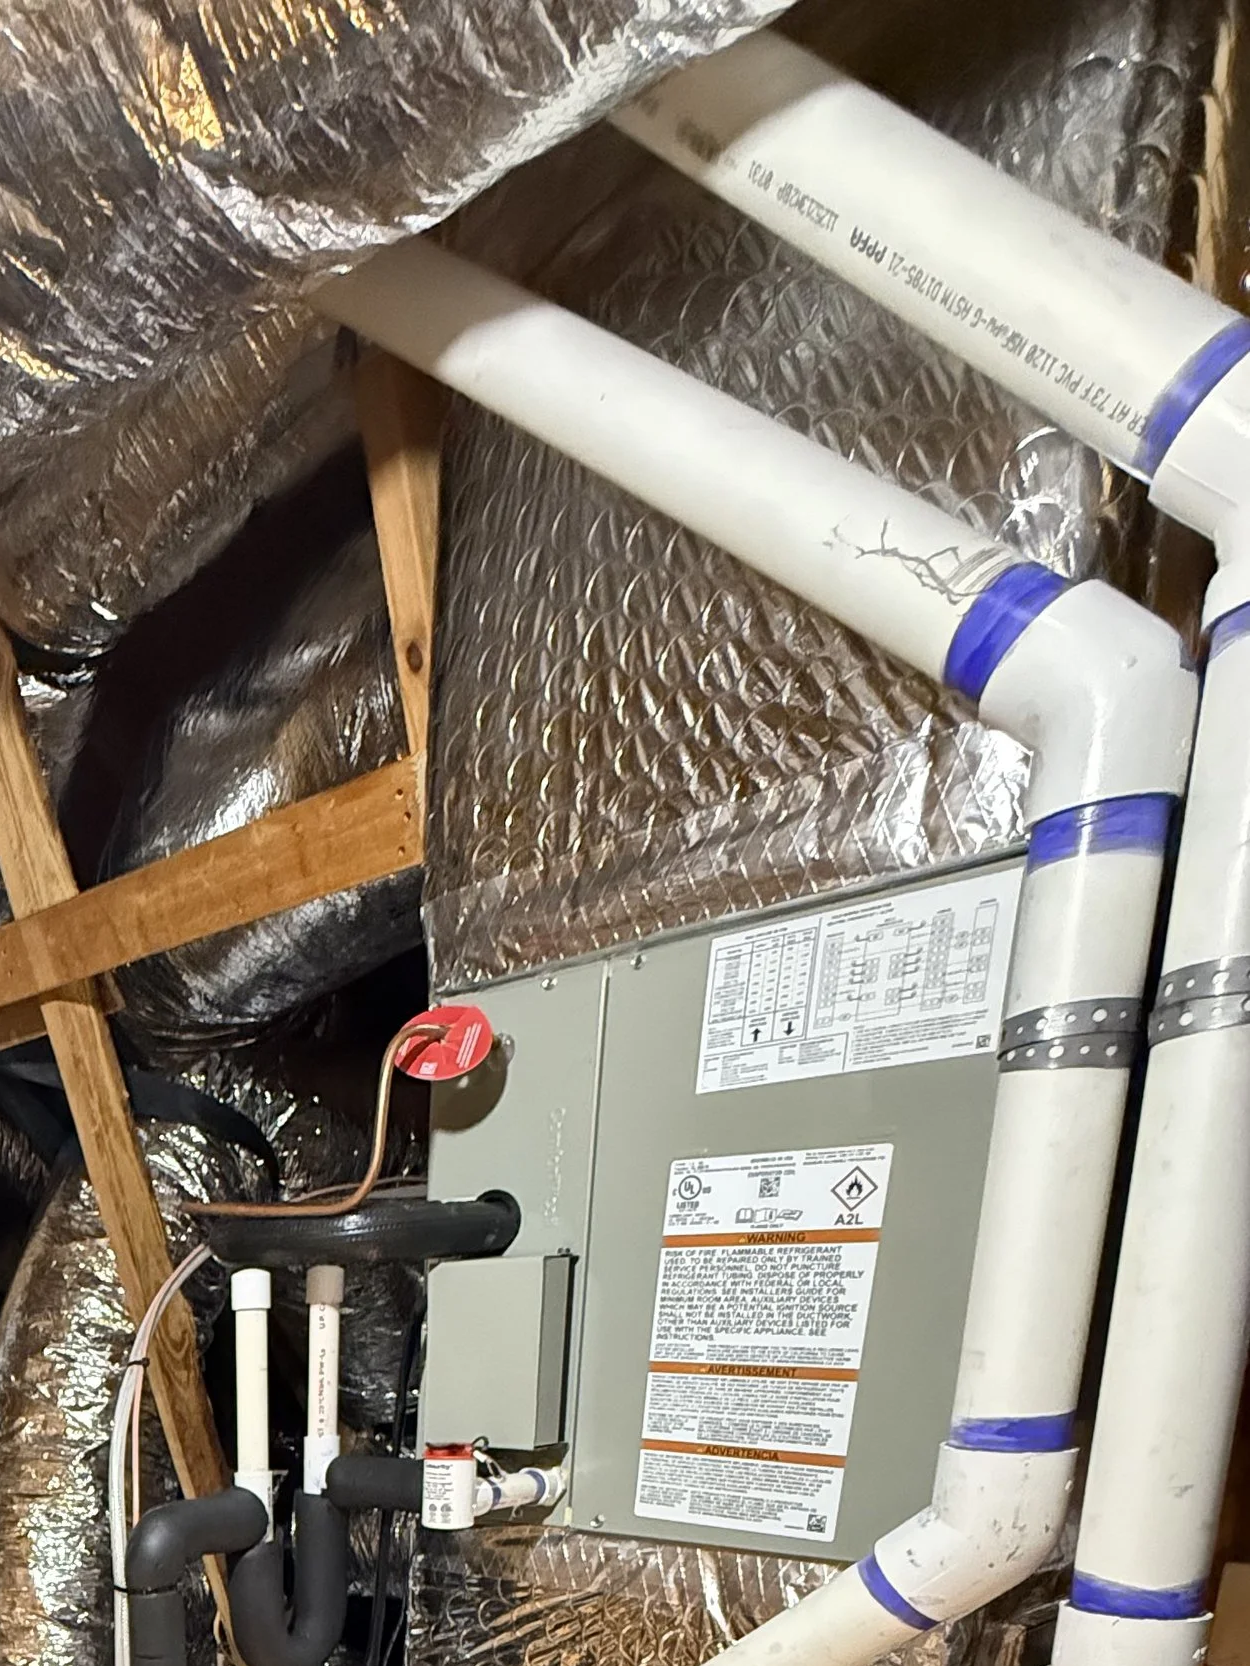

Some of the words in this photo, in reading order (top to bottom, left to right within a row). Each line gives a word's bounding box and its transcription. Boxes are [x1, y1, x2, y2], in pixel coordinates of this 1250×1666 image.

[849, 225, 889, 265] PPFA
[887, 251, 944, 302] D1785-21
[939, 287, 974, 321] ASTM
[1023, 343, 1059, 377] 1120
[1053, 362, 1085, 395] PVC
[1106, 399, 1132, 424] AT
[834, 1214, 864, 1226] A2L
[746, 1232, 806, 1244] WARNING
[721, 1247, 774, 1255] FLAMMABLE
[776, 1246, 842, 1254] REFRIGERANT
[716, 1256, 759, 1264] REPAIRED
[760, 1255, 783, 1263] ONLY
[801, 1254, 842, 1262] TRAINED
[769, 1263, 787, 1271] NOT
[789, 1262, 842, 1270] PUNCTURE
[662, 1272, 718, 1280] REFRIGERANT
[757, 1271, 796, 1279] DISPOSE
[813, 1270, 864, 1278] PROPERLY
[753, 1279, 794, 1287] FEDERAL
[721, 1287, 737, 1295] SEE
[739, 1287, 792, 1295] INSTALLERS
[658, 1310, 683, 1318] SHALL
[717, 1311, 763, 1319] INSTALLED
[765, 1311, 774, 1319] IN
[777, 1311, 793, 1319] THE
[686, 1318, 708, 1326] THAN
[755, 1319, 793, 1327] DEVICES
[830, 1320, 850, 1328] FOR
[656, 1325, 671, 1333] USE
[674, 1325, 694, 1333] WITH
[713, 1326, 751, 1334] SPECIFIC
[808, 1327, 827, 1335] SEE
[707, 1365, 798, 1378] AVERTISSEMENT
[705, 1445, 780, 1461] ADVERTENCIA
